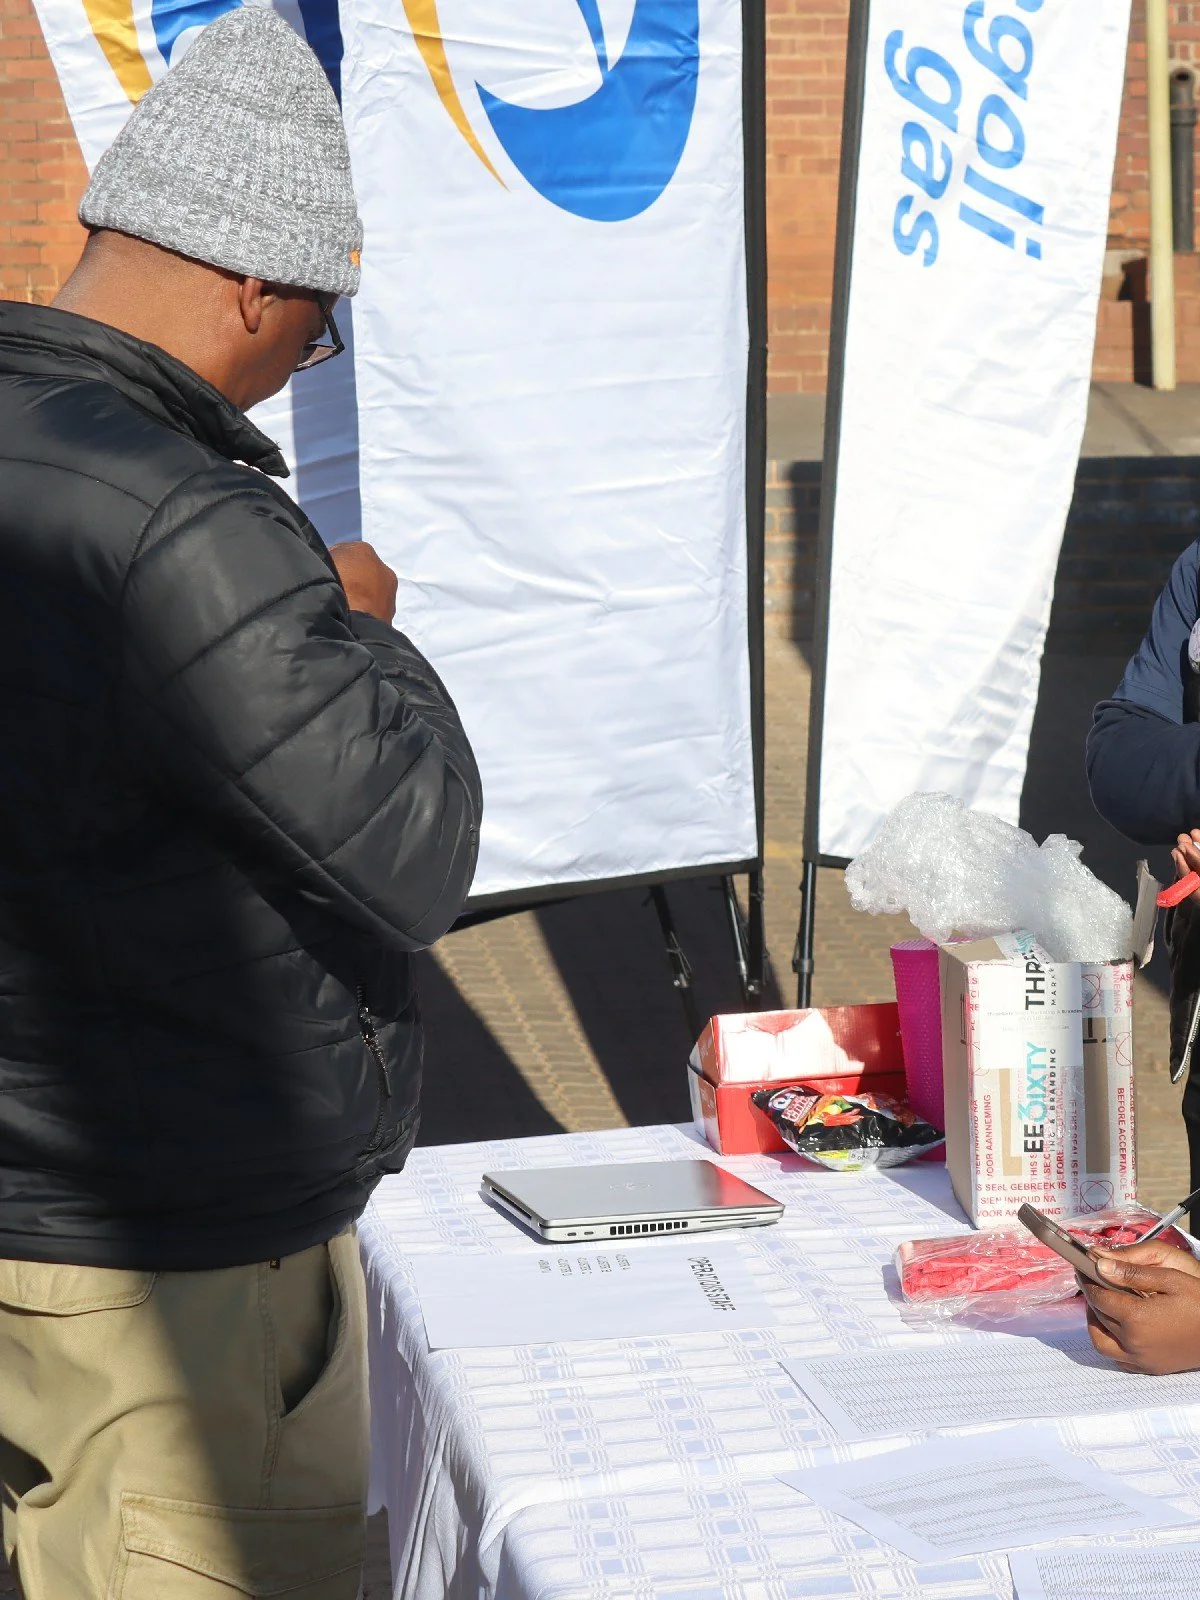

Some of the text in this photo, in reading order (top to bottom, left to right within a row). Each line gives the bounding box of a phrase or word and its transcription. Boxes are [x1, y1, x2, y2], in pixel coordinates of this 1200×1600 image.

[884, 29, 962, 267] gas
[959, 0, 1045, 260] goli
[1049, 1048, 1057, 1111] BRANDING
[983, 1094, 993, 1151] AANNEMING
[1117, 1087, 1128, 1191] BEFORE ACCEPTANCE
[1043, 1195, 1057, 1203] NA
[1058, 1181, 1067, 1190] IS
